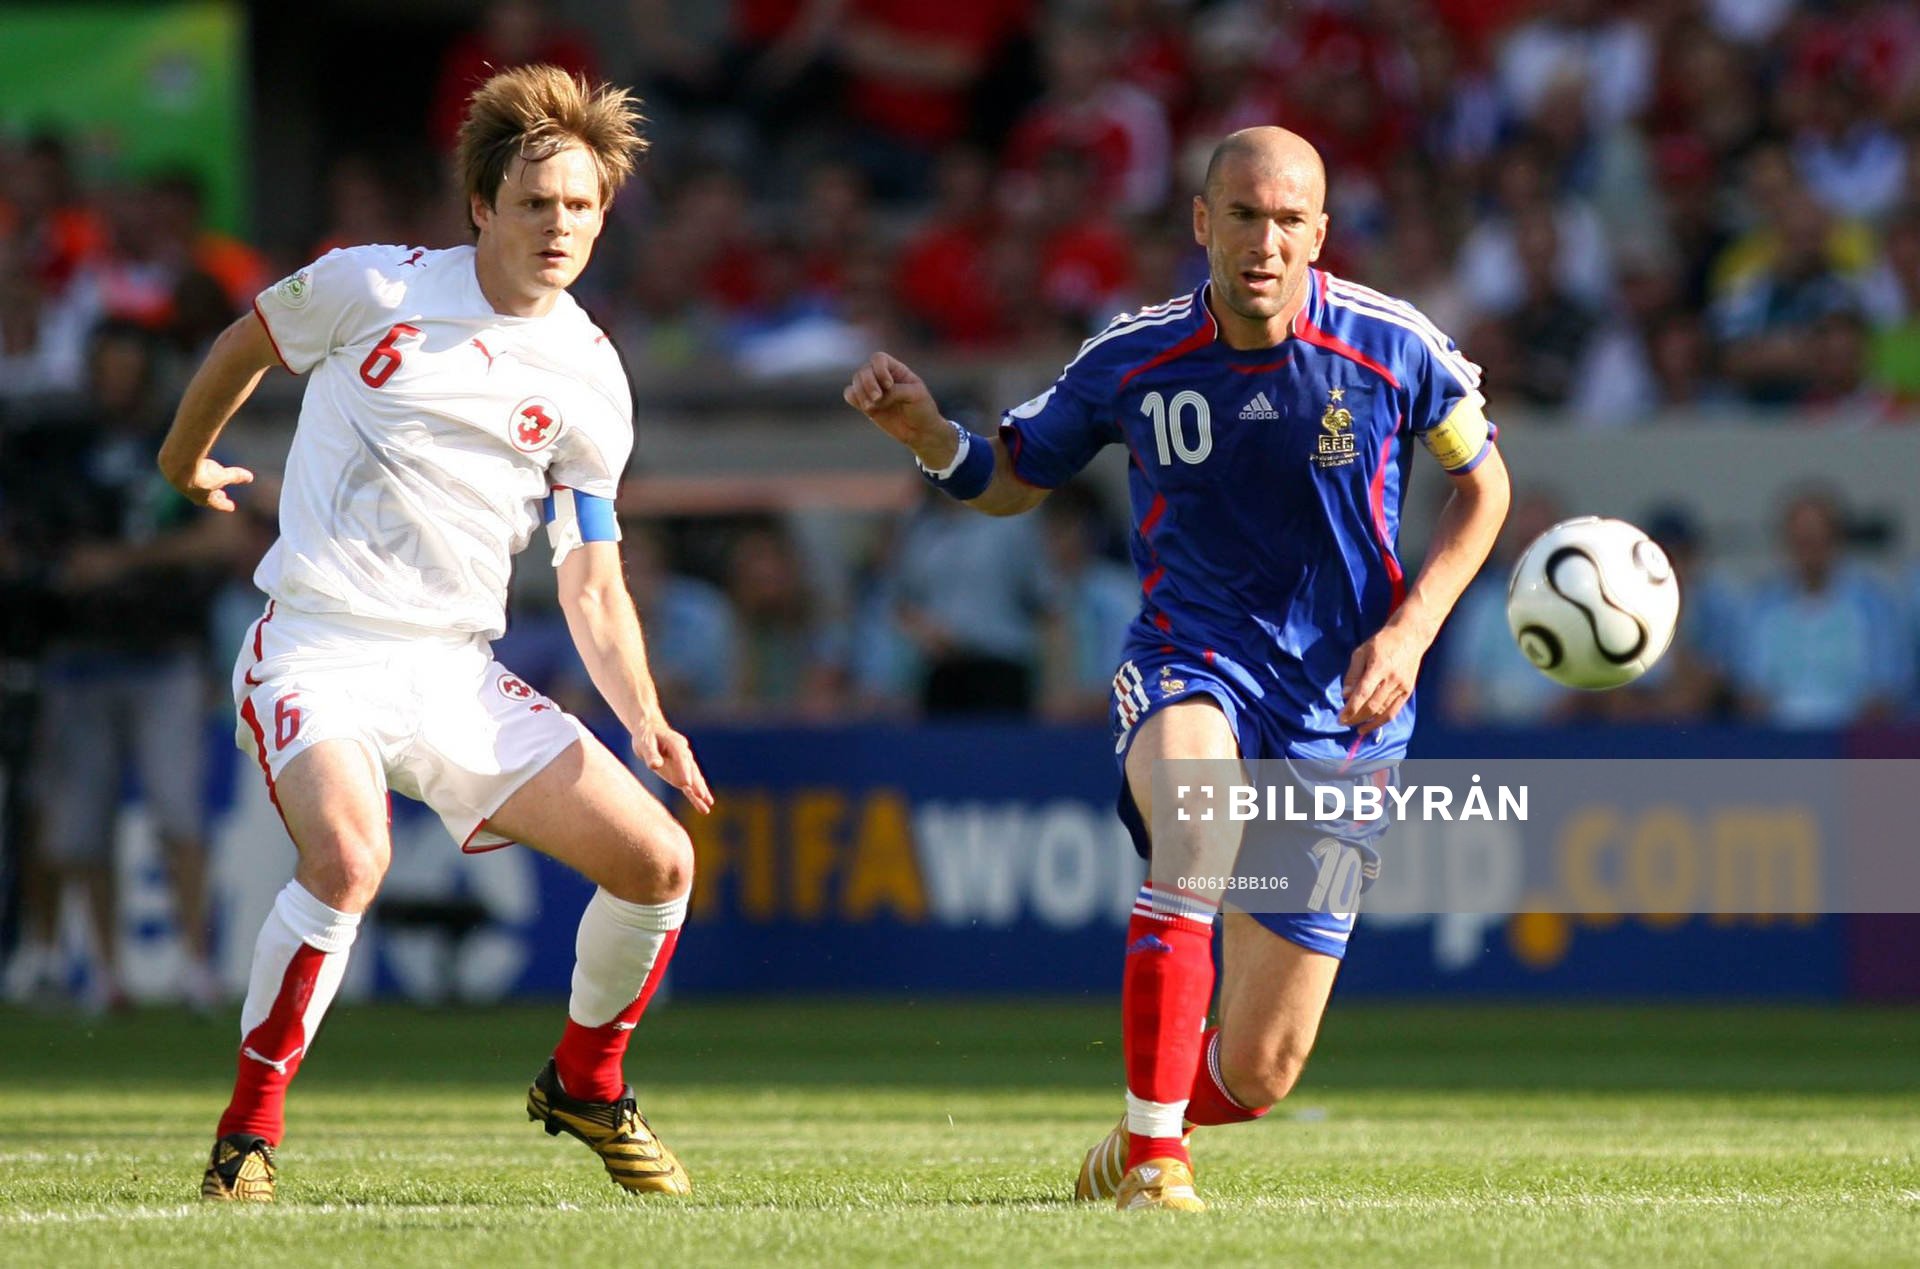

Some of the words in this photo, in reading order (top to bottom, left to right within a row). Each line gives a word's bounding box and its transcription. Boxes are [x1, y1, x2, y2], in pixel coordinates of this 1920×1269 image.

[360, 323, 422, 389] 6
[1140, 390, 1213, 466] 10
[1239, 410, 1279, 420] adidas
[275, 692, 301, 751] 6
[1307, 837, 1362, 920] 10
